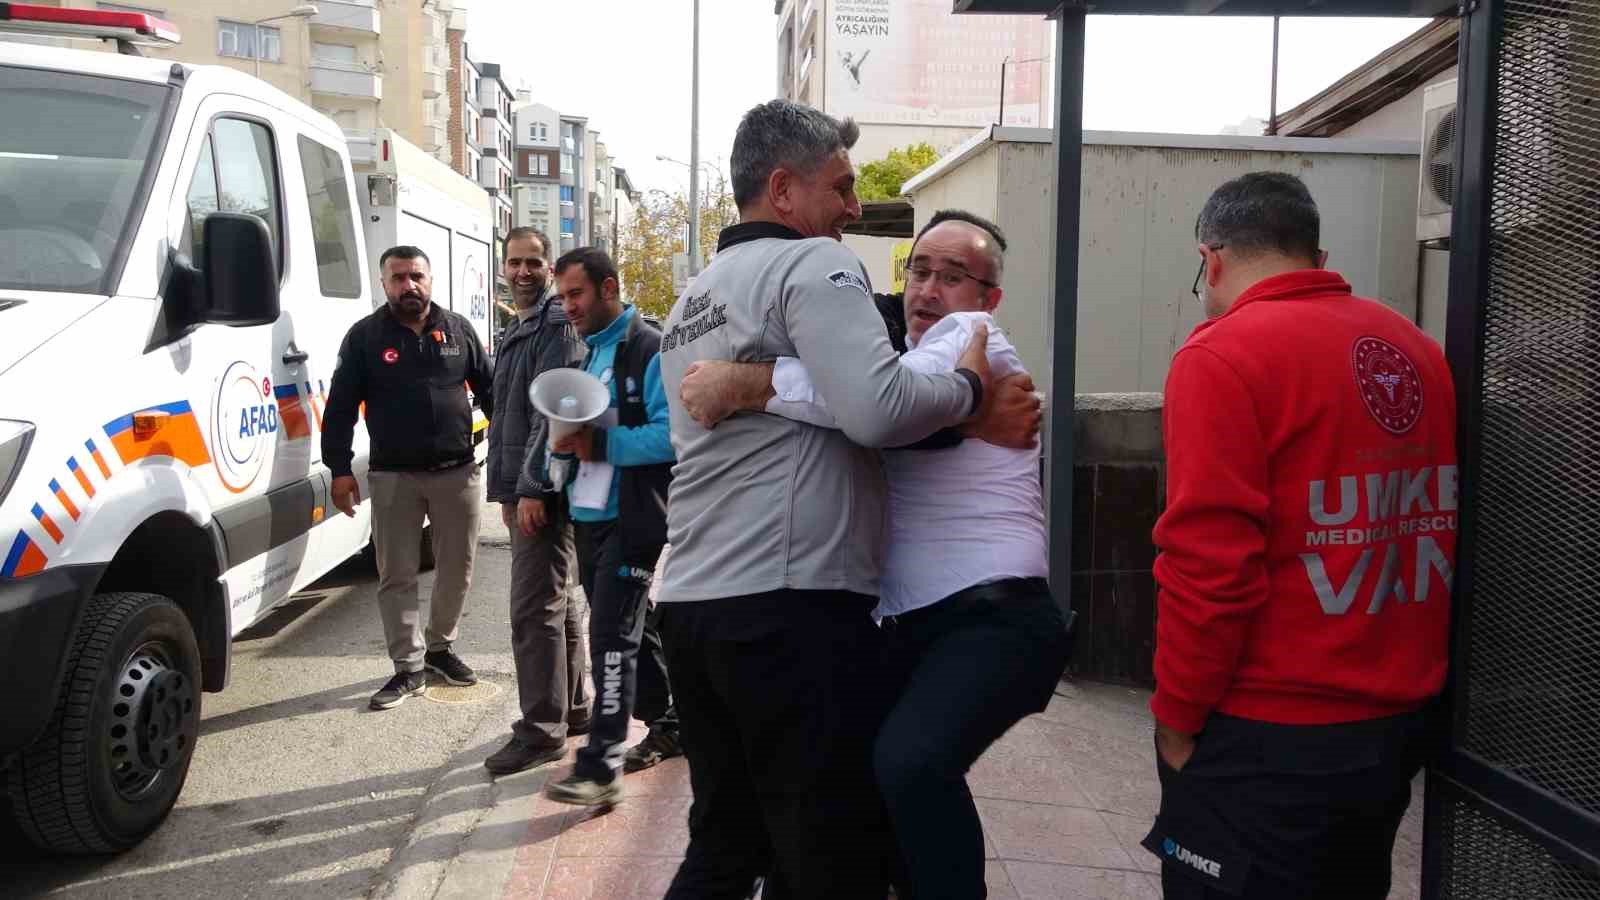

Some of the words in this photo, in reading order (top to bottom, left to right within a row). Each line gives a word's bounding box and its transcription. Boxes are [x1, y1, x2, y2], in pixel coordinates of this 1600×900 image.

[835, 23, 889, 38] YAŞAYIN
[239, 404, 277, 438] AFAD
[1306, 523, 1397, 547] MEDICAL
[1399, 516, 1458, 536] RESCU
[1298, 535, 1455, 615] VAN
[601, 651, 623, 716] UMKE
[1175, 843, 1222, 878] UMKE
